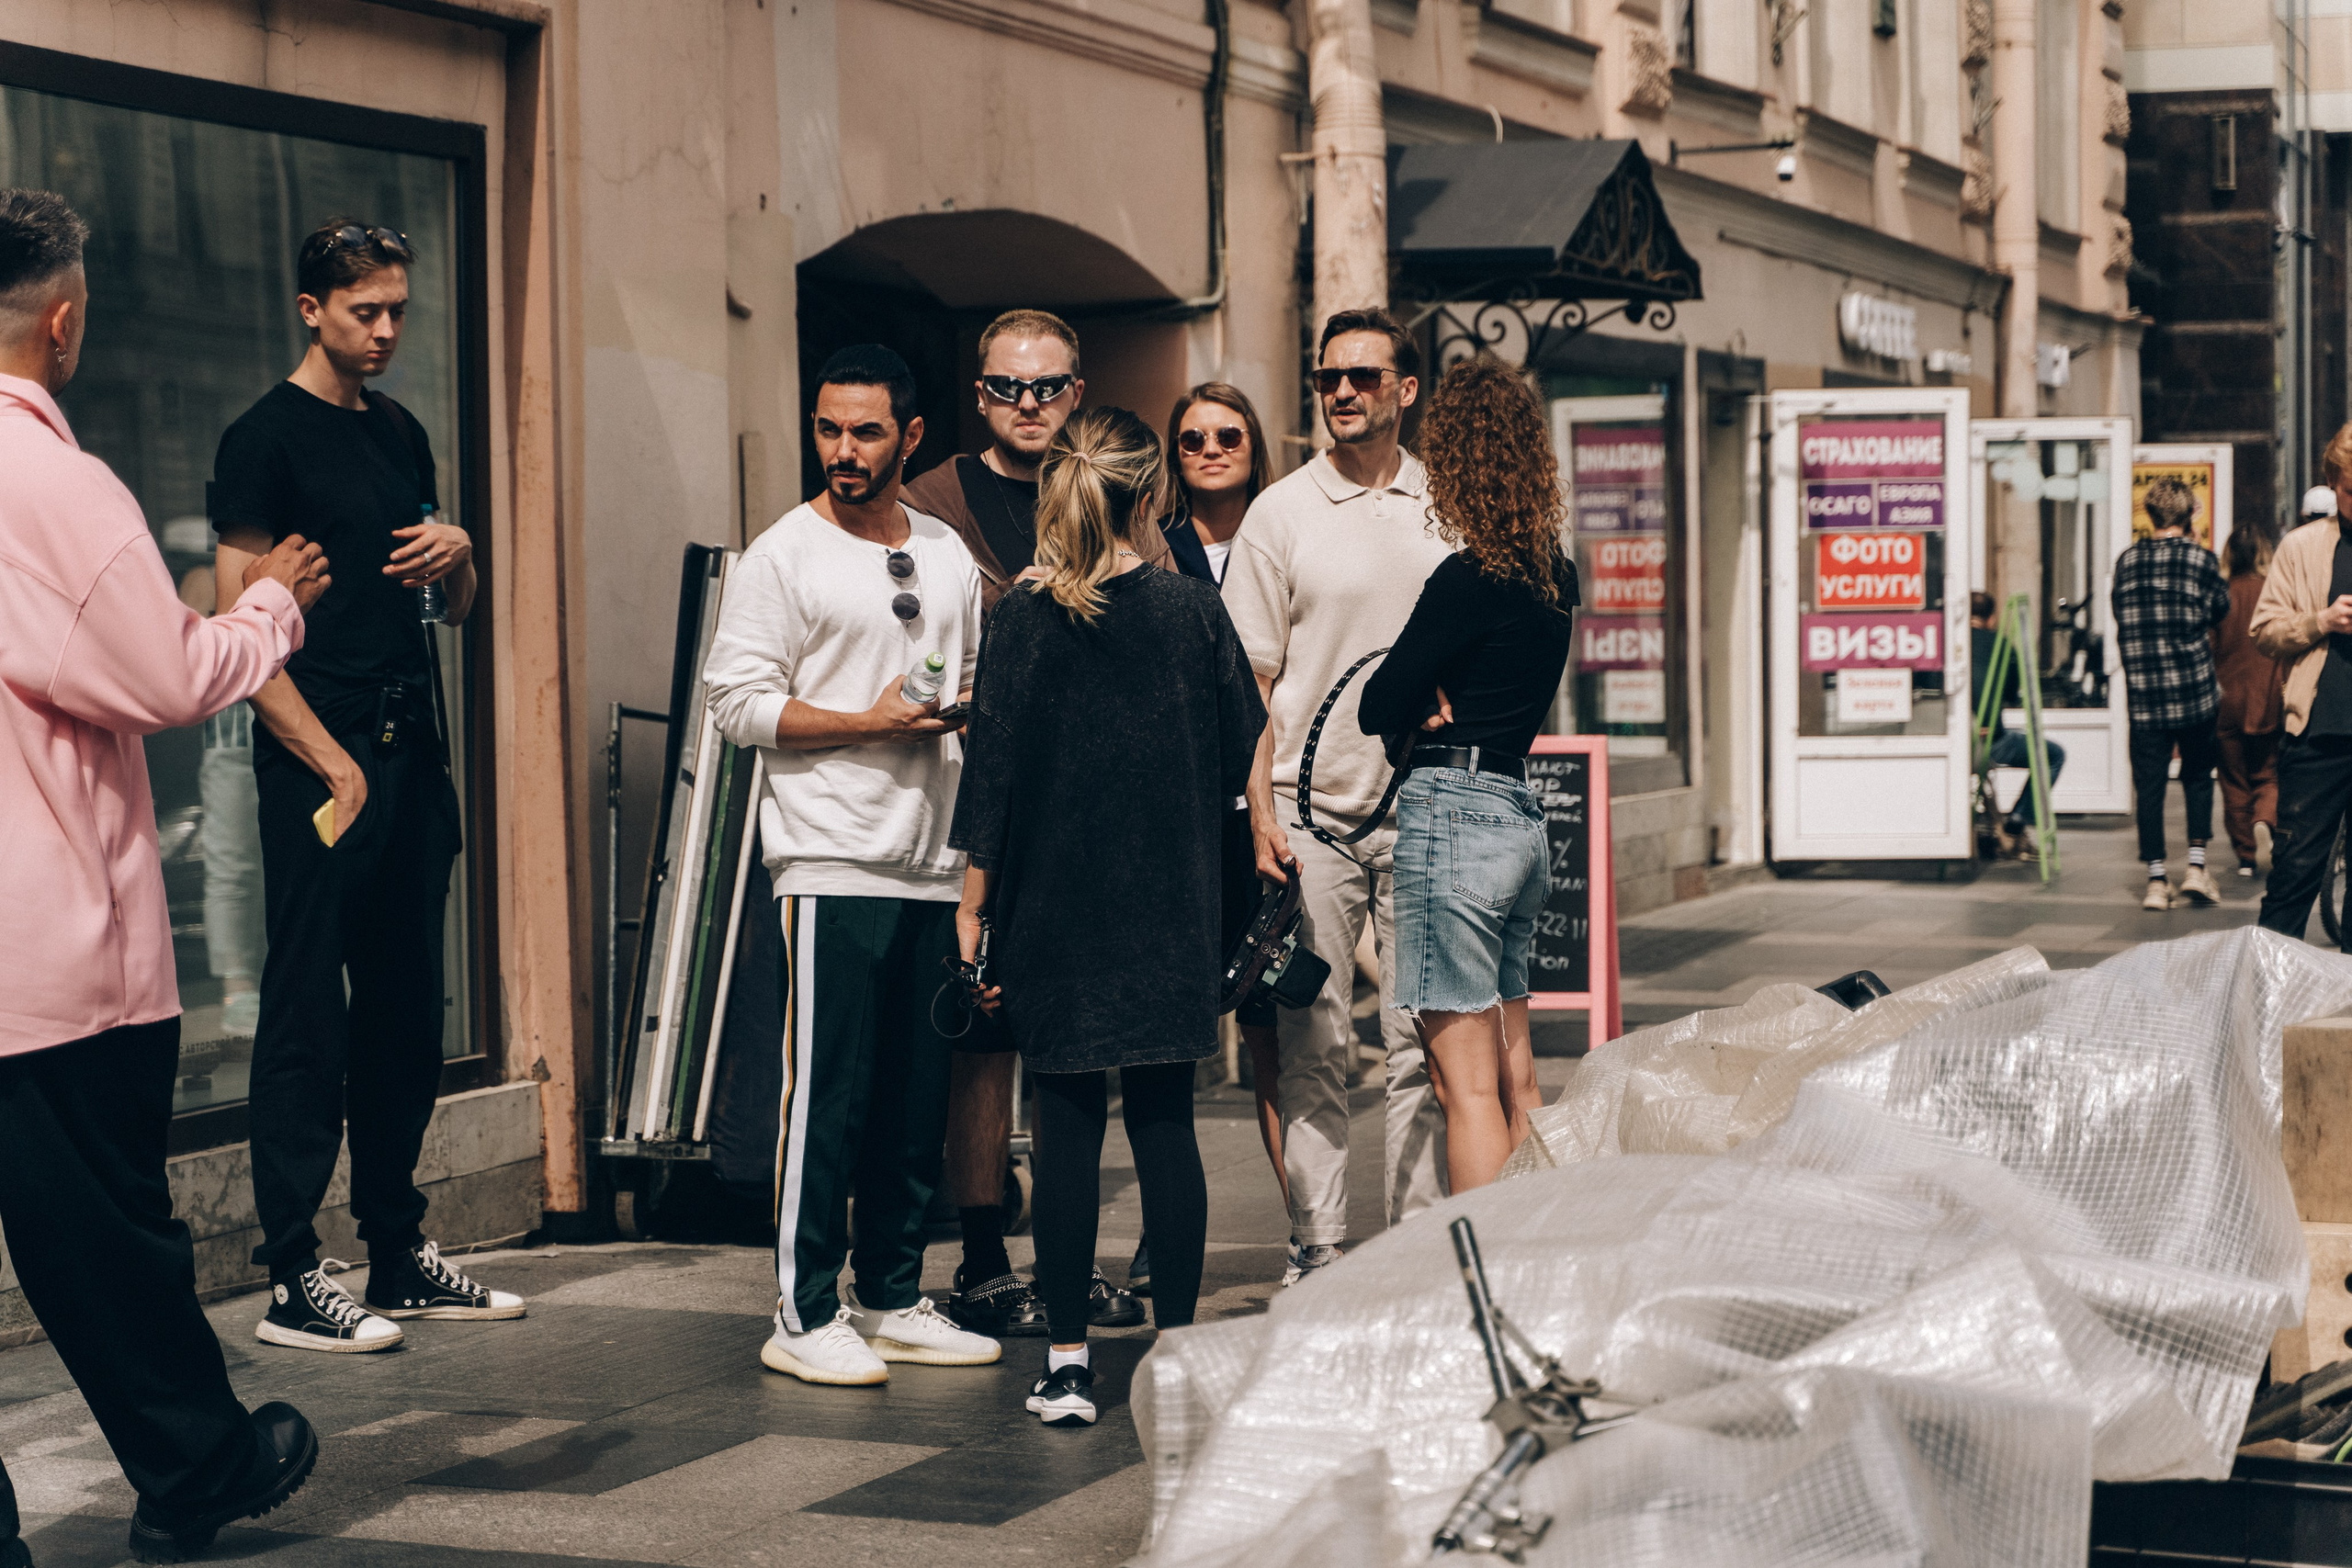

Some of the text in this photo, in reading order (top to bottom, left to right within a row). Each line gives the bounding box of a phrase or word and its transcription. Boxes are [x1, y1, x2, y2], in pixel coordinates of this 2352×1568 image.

[1803, 435, 1943, 465] СТРАХОВАНИЕ
[1808, 494, 1871, 516] ОСАГО
[1879, 484, 1942, 502] ЕВРОПА
[1889, 506, 1933, 525] АЗИЯ
[1830, 535, 1914, 565] ФОТО
[1820, 573, 1922, 600] УСЛУГИ
[1808, 625, 1938, 661] ВИЗЫ
